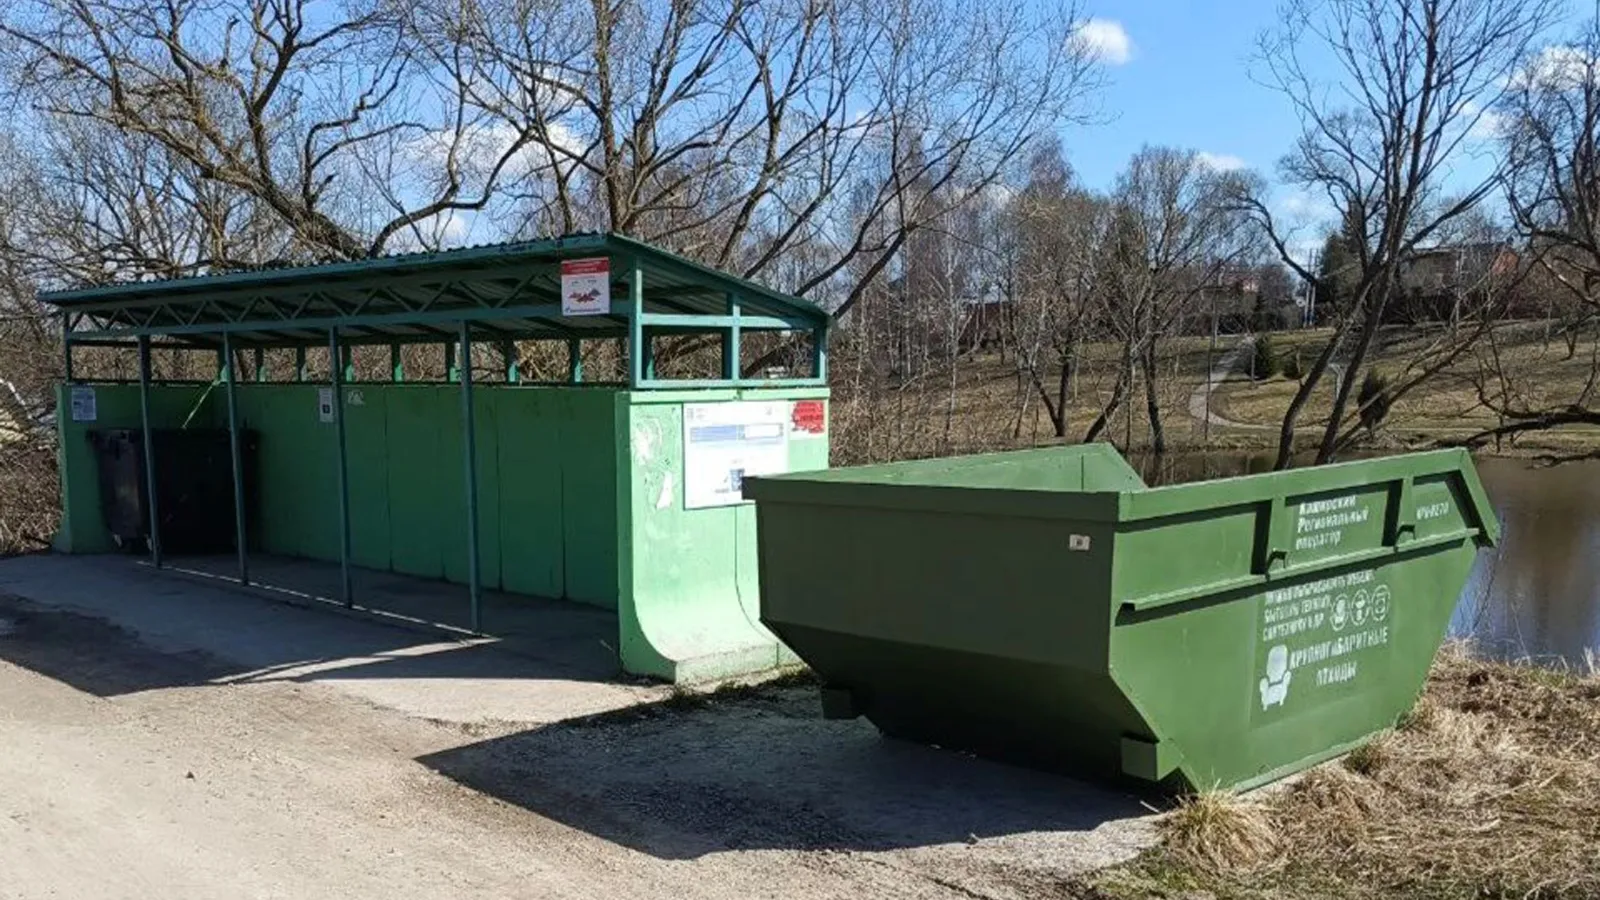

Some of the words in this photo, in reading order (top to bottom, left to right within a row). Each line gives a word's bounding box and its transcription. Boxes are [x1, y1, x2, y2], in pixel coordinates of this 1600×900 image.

[1299, 495, 1356, 515] Каширский
[1297, 505, 1369, 533] Региональный
[1296, 531, 1341, 550] оператор
[1290, 626, 1388, 670] КРУПНОГАБАРИТНЫЕ
[1315, 660, 1358, 687] ОТХОДЫ
